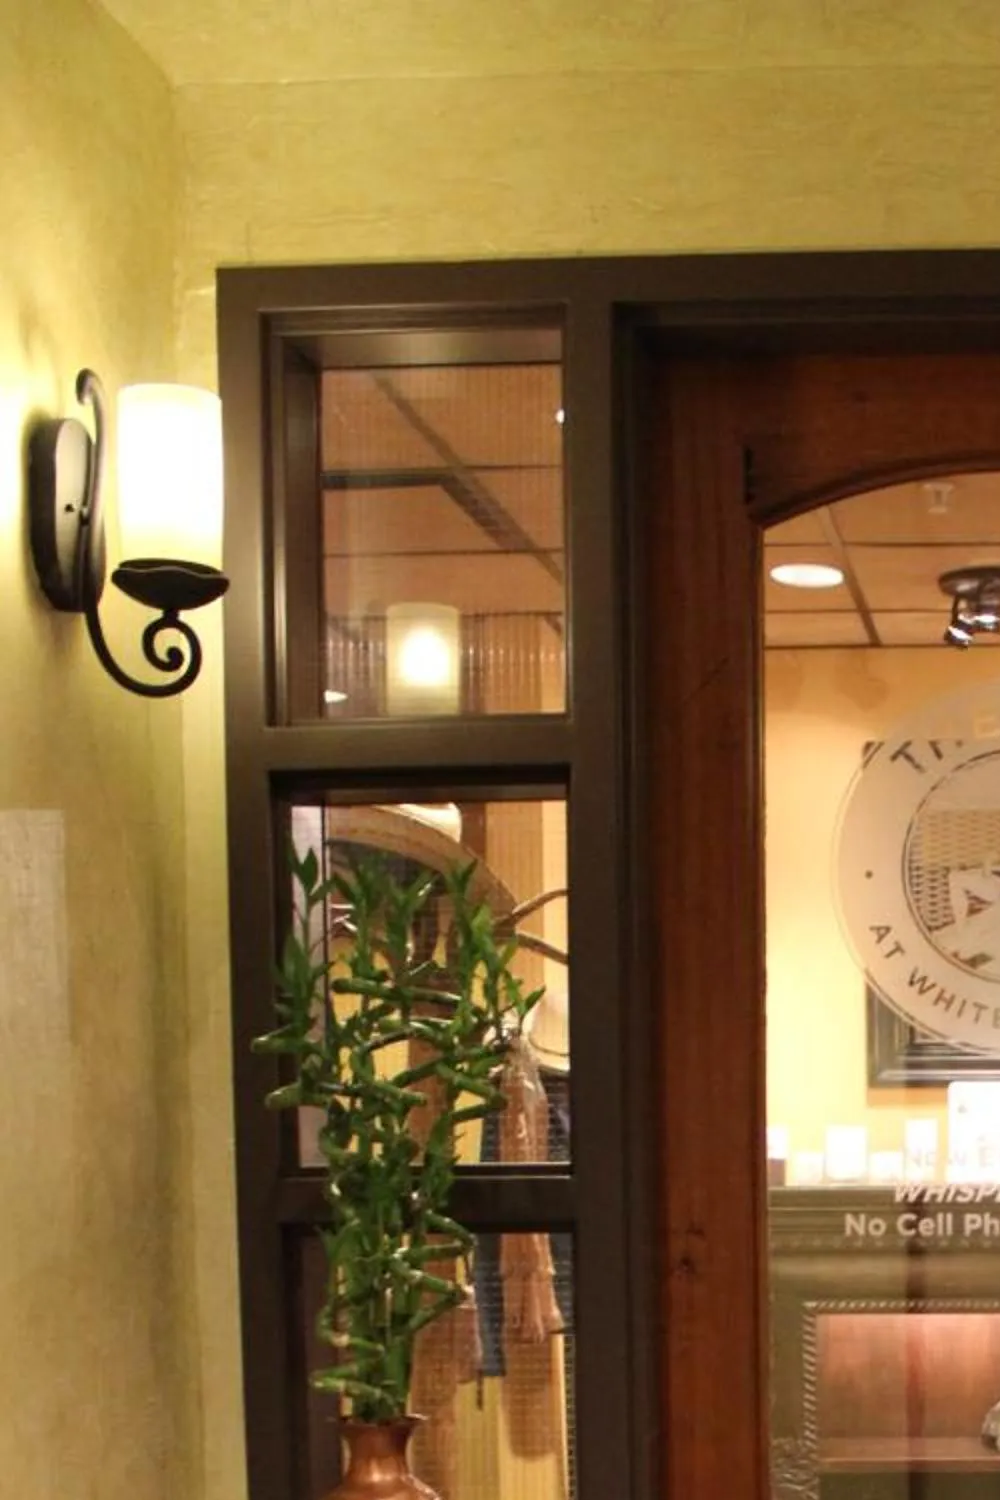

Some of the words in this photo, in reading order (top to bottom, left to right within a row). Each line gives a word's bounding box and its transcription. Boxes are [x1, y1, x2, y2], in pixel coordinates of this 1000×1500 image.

[869, 924, 906, 960] AT
[844, 1213, 887, 1237] No
[896, 1213, 954, 1237] Cell
